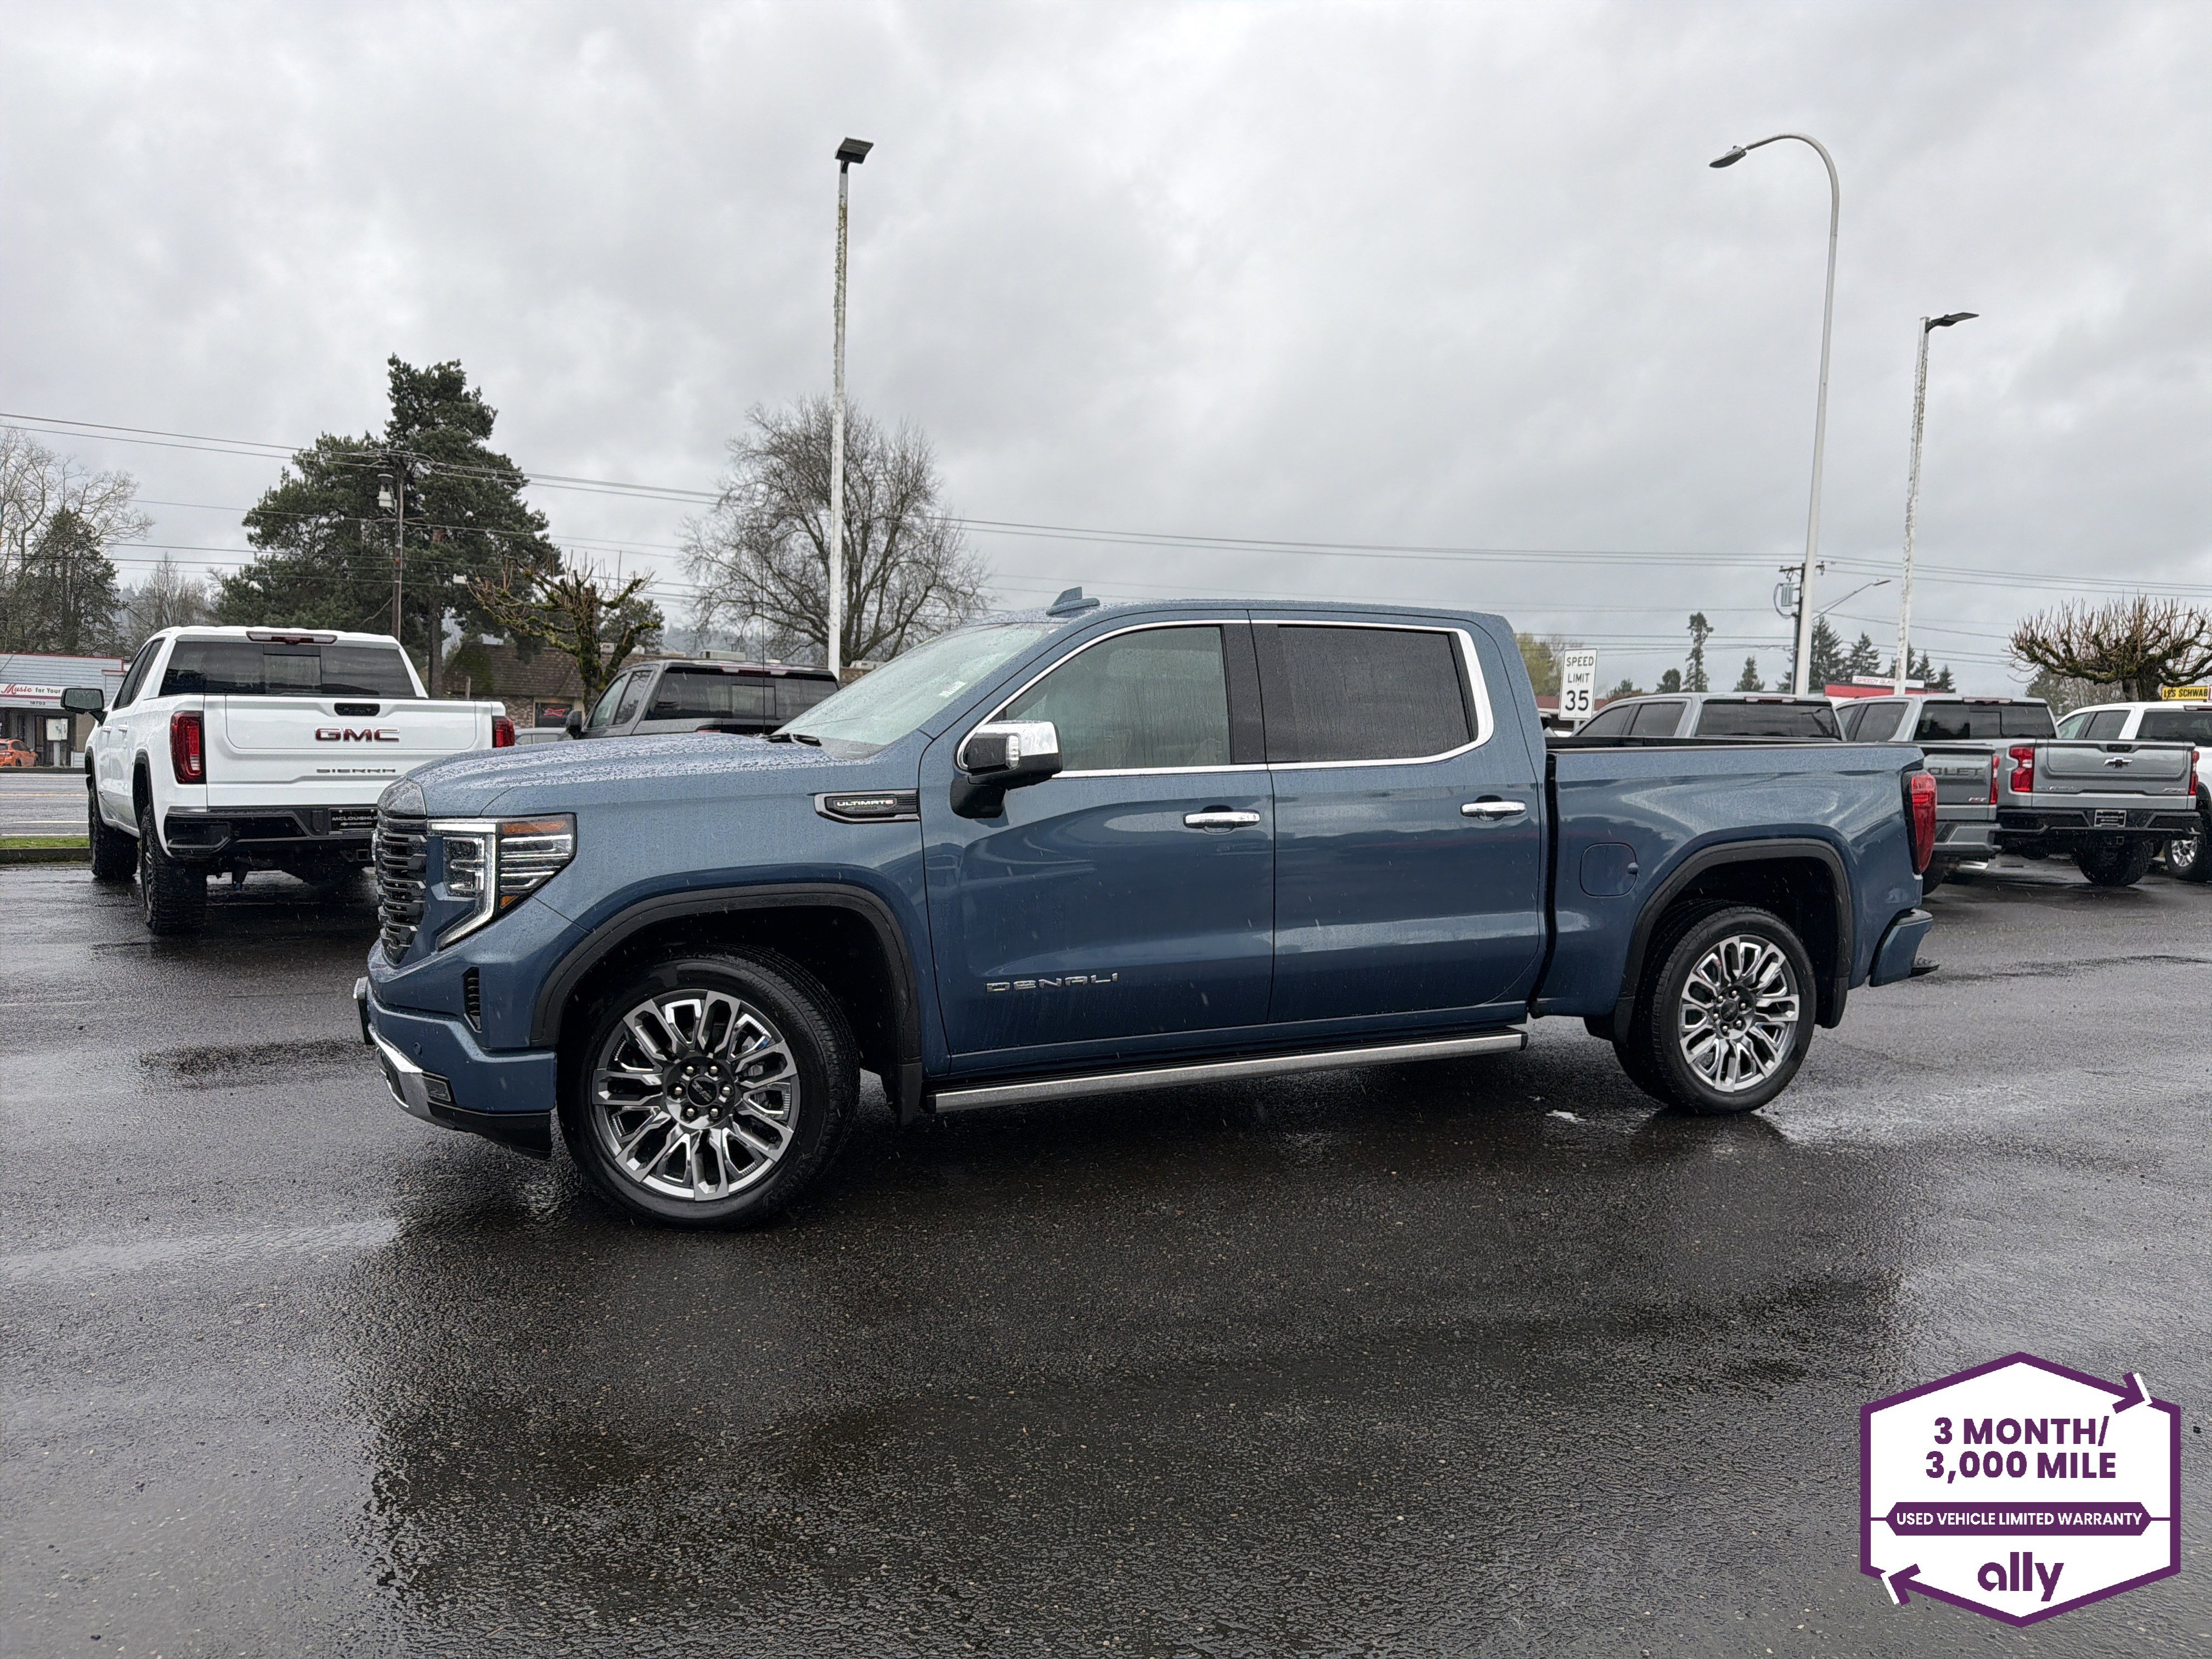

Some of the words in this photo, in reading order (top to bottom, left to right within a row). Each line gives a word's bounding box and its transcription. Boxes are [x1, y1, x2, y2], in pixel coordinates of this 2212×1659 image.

[1566, 656, 1594, 667] SPEED
[1567, 673, 1590, 683] LIMIT
[1, 684, 32, 695] Music
[2179, 689, 2208, 697] SCHWAB
[1565, 690, 1589, 710] 35
[315, 727, 399, 742] GMC
[986, 973, 1118, 992] DENALI
[691, 1080, 713, 1102] GMC
